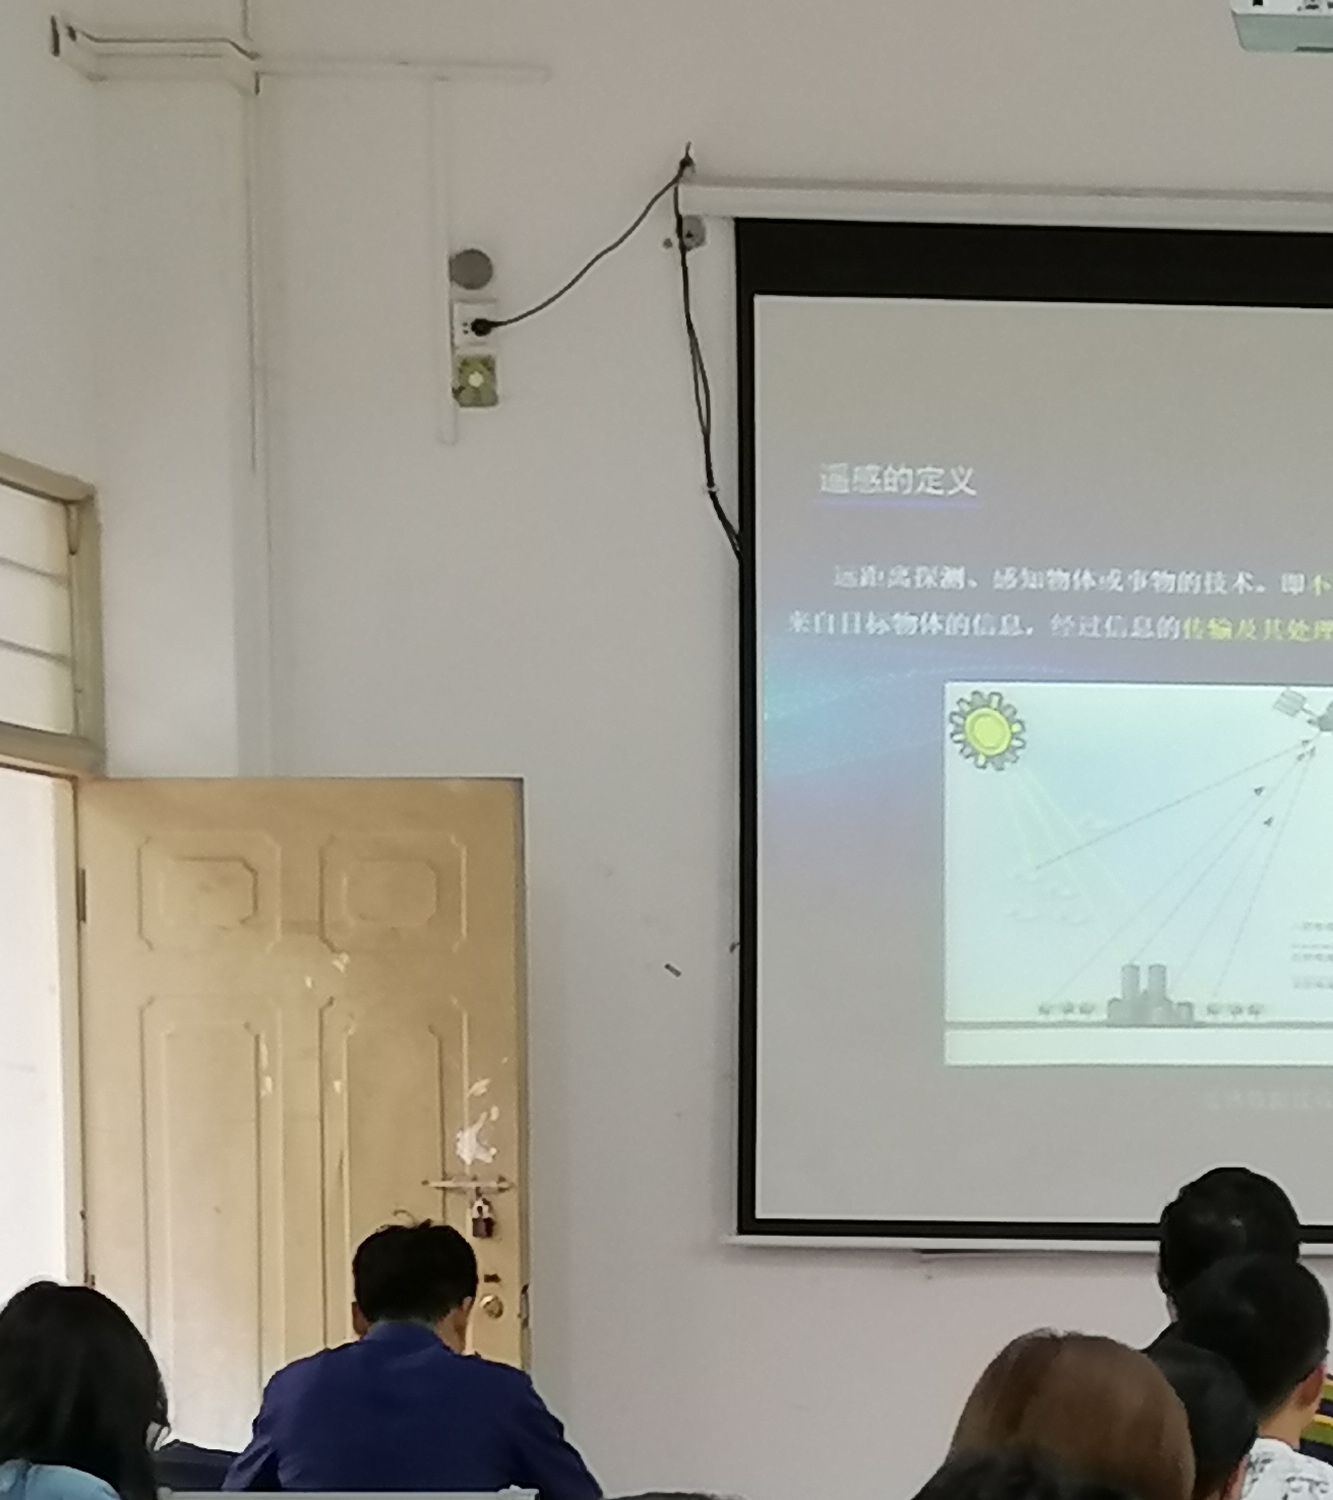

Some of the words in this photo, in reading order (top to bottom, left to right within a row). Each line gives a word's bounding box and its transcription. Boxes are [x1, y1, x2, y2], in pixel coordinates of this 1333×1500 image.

[820, 462, 977, 496] 遥感的定义
